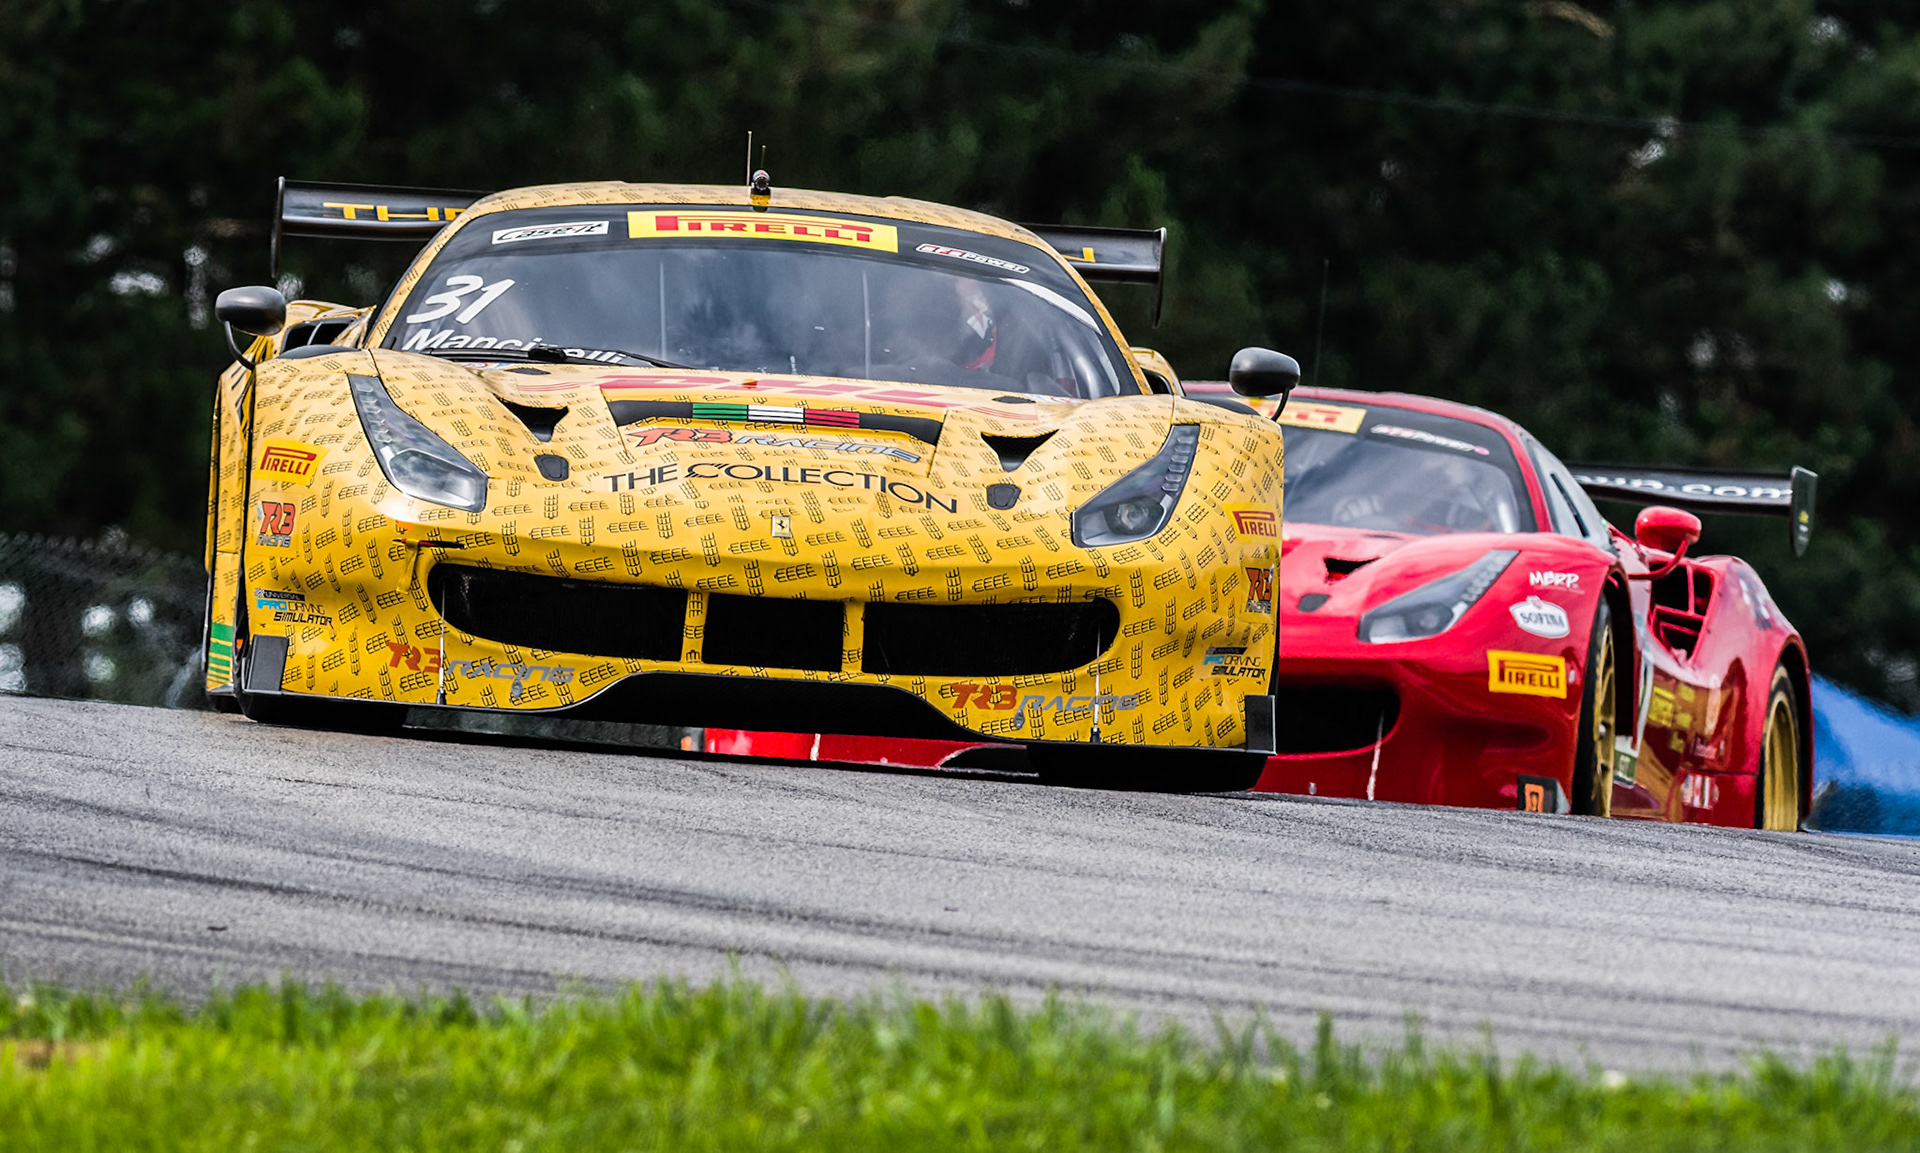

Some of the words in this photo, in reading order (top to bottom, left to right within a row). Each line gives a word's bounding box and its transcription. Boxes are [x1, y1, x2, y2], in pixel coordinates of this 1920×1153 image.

[655, 215, 874, 242] PIRELLI
[406, 275, 516, 324] 31
[260, 446, 317, 476] PIRELLI
[735, 435, 922, 464] RACING
[603, 463, 679, 492] THE
[683, 462, 958, 514] COLLECTION
[1232, 511, 1278, 538] PIRELLI
[256, 534, 292, 548] RACING
[1529, 570, 1580, 588] MBRP
[273, 611, 334, 627] SIMULATOR
[289, 601, 326, 615] DRIVING
[1498, 659, 1560, 689] PIRELLI
